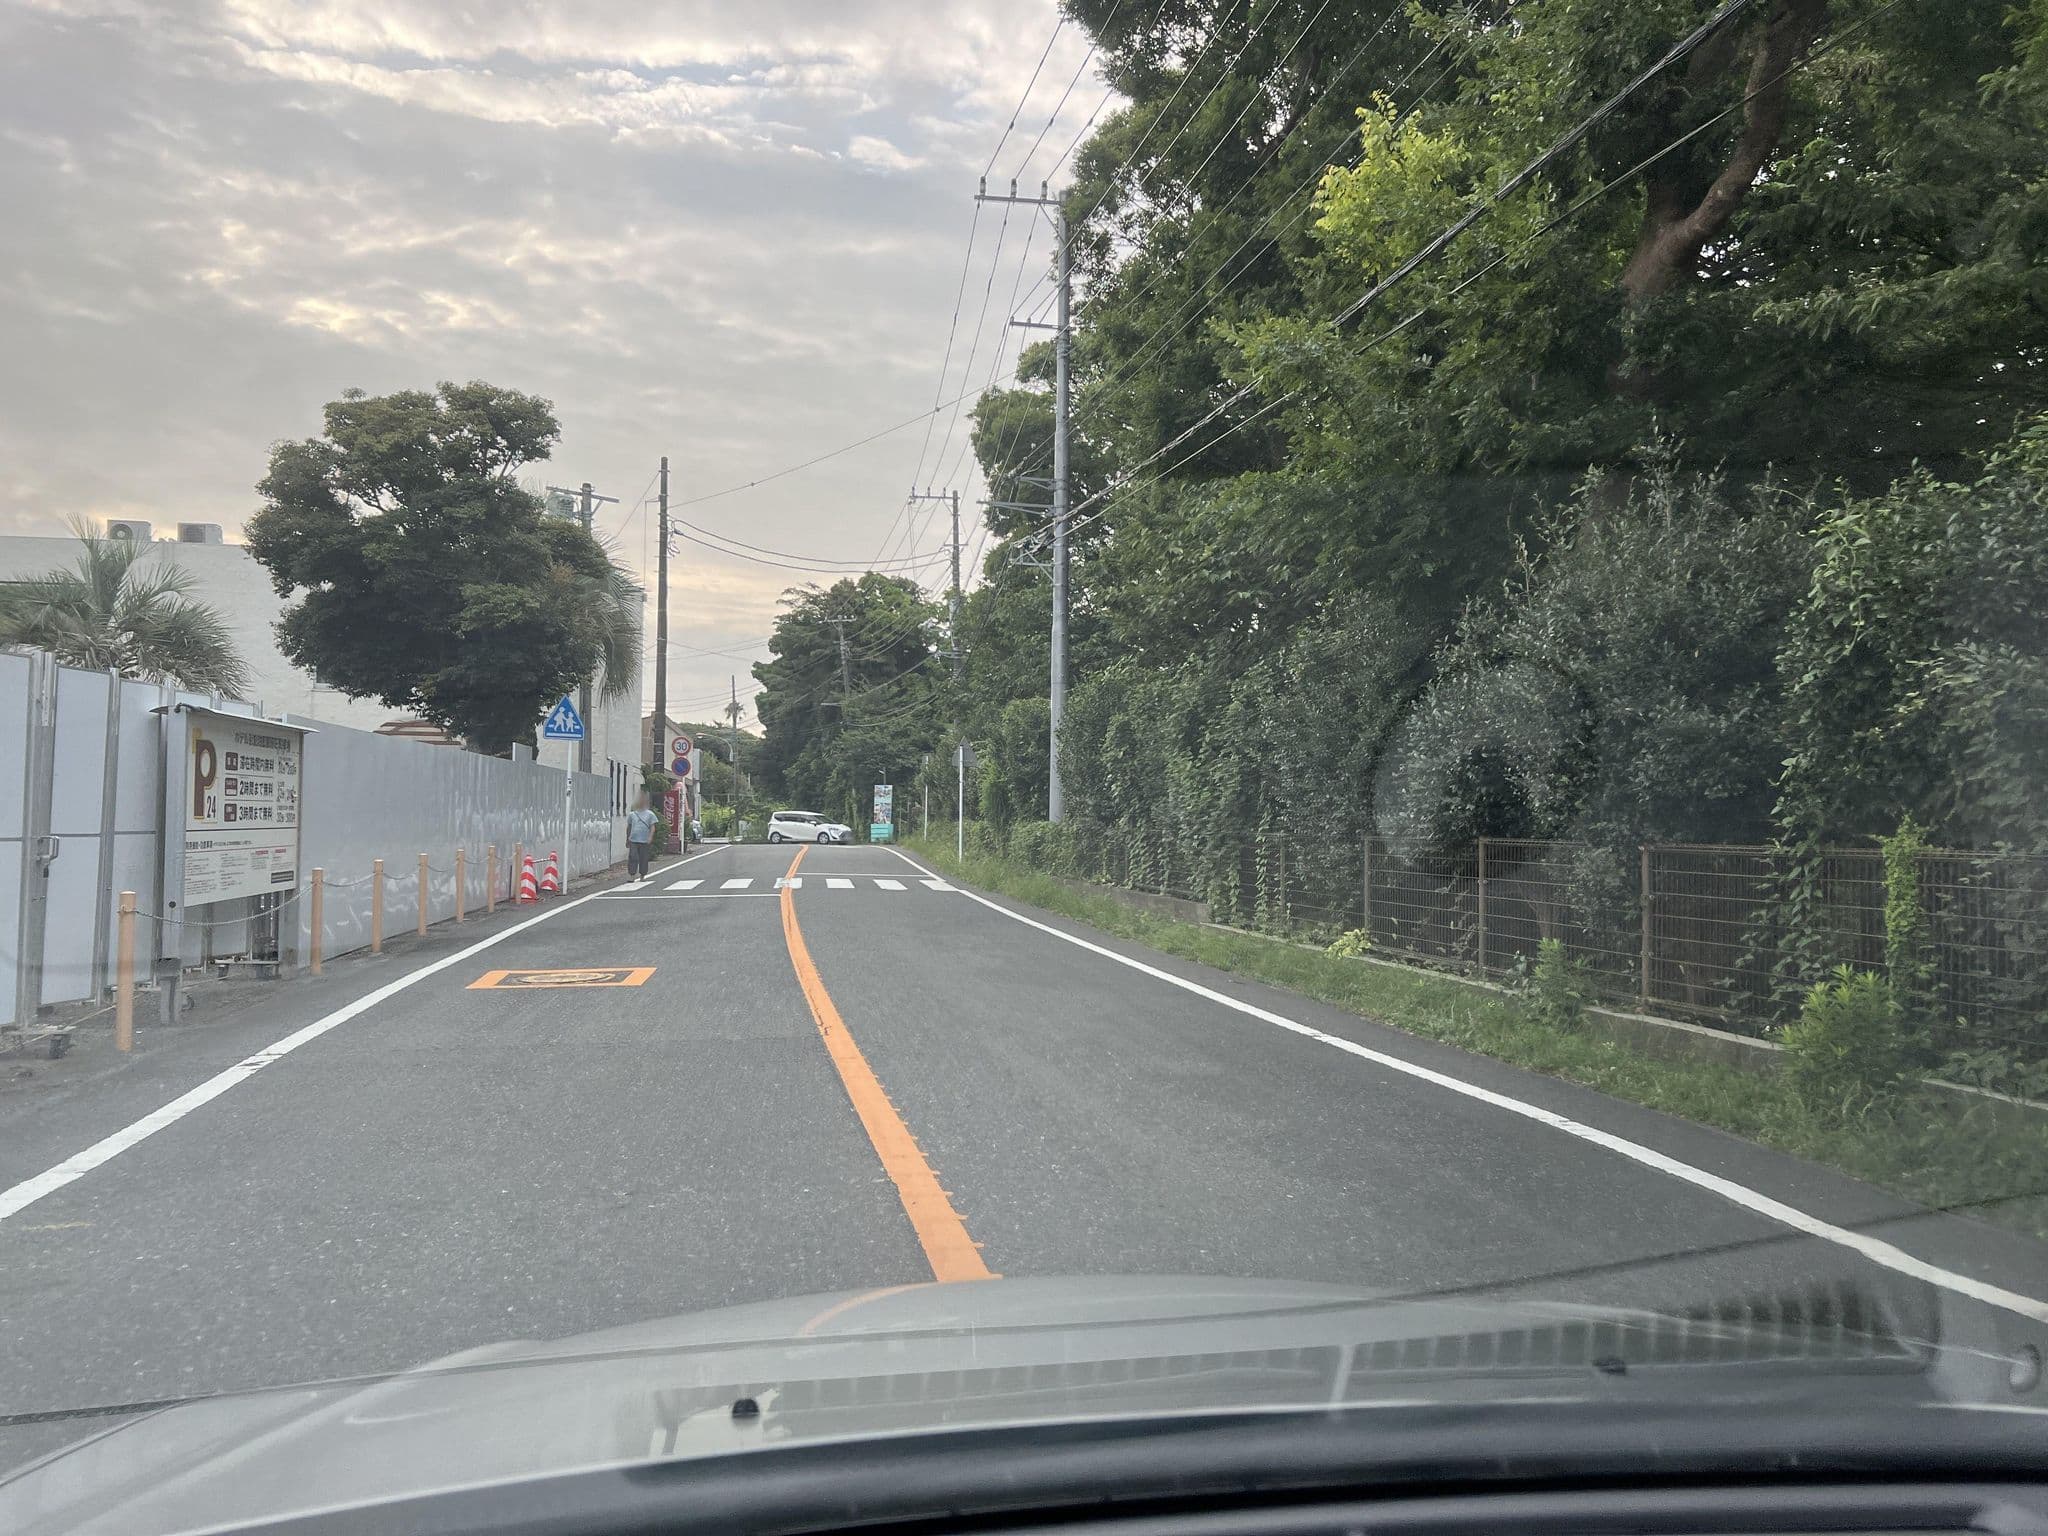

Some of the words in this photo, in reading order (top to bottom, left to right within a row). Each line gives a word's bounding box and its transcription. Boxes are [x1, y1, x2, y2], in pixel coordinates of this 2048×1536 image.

[676, 742, 687, 751] 30
[194, 739, 217, 819] P
[239, 780, 273, 797] 2時間まで無料
[206, 795, 217, 819] 24
[239, 806, 273, 822] 3時間まで無料
